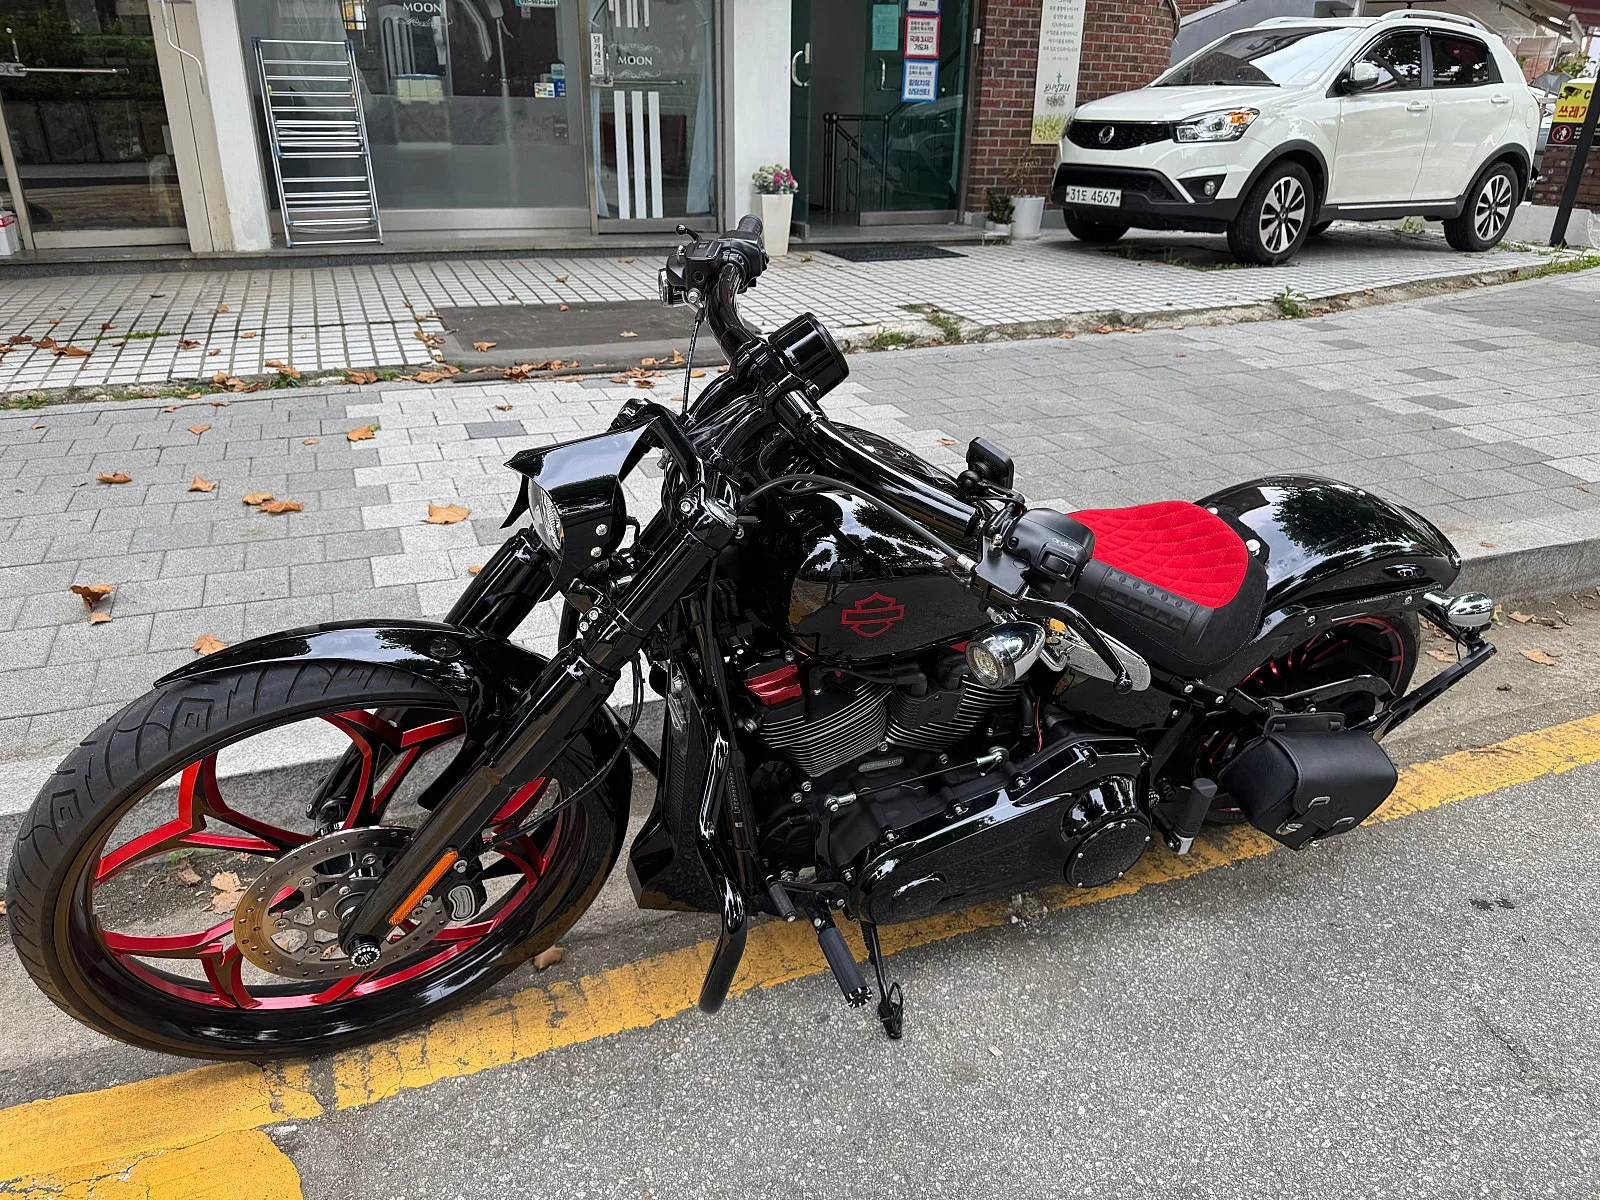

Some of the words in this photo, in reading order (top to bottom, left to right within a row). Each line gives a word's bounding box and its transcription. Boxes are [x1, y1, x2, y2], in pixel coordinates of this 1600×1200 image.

[403, 2, 442, 13] MOON
[593, 35, 602, 66] 당기세요
[618, 55, 653, 66] MOON
[1090, 190, 1116, 204] 4567
